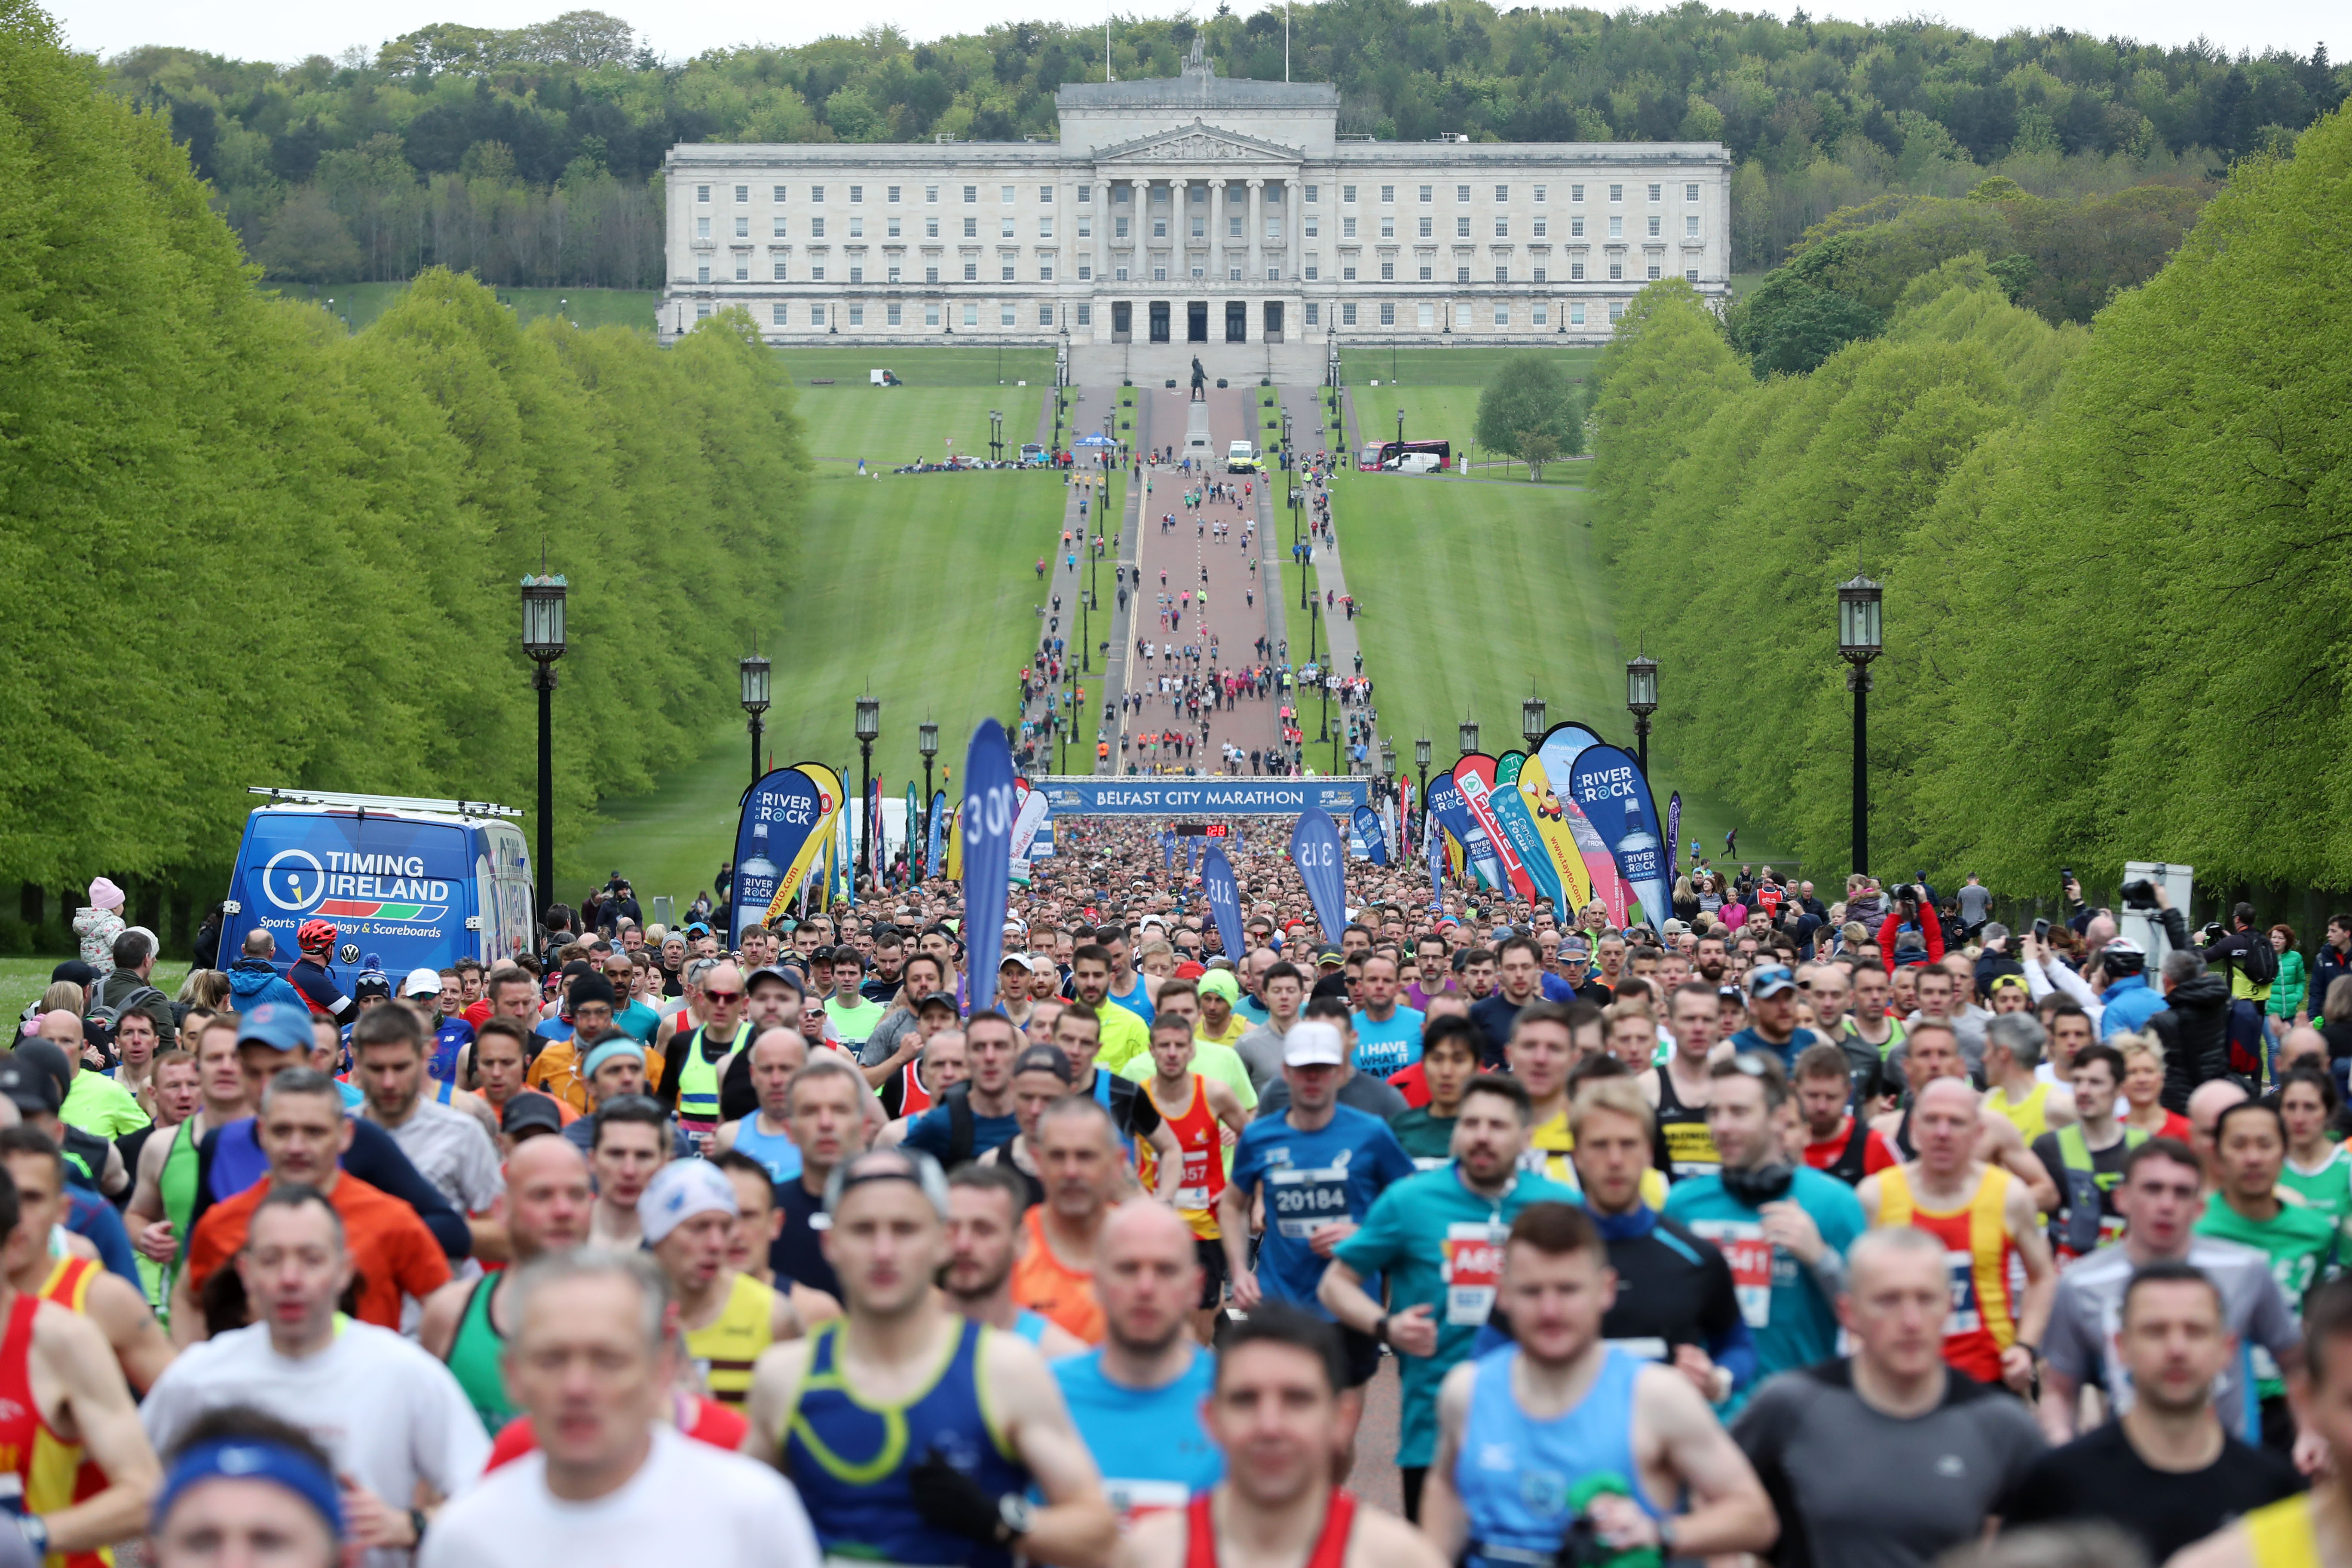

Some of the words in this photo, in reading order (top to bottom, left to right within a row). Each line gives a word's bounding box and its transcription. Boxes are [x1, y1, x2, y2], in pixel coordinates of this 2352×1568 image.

[1582, 766, 1632, 787] RIVER
[1435, 787, 1461, 802] RIVE
[1576, 775, 1586, 803] DEEP
[1584, 780, 1635, 802] ROCK
[762, 792, 812, 810] RIVER
[1097, 791, 1161, 806] BELFAST
[1165, 791, 1201, 805] CITY
[1206, 791, 1304, 805] MARATHON
[1437, 796, 1467, 812] ROC
[760, 807, 809, 825] ROCK
[1509, 820, 1529, 852] Focus
[1518, 818, 1537, 848] Cancer
[1470, 839, 1490, 849] RIVER
[1472, 845, 1491, 855] ROCK
[326, 851, 423, 877] TIMING
[1627, 851, 1655, 863] RIVER
[1550, 836, 1583, 904] www.tayto.com
[1629, 860, 1656, 873] ROCK
[329, 875, 449, 901] IRELAND
[745, 878, 773, 888] RIVER
[744, 887, 772, 898] ROCK
[259, 916, 295, 929] Sports
[298, 919, 360, 934] Tology
[361, 923, 371, 933] &
[373, 925, 441, 938] Scoreboards
[1360, 1044, 1365, 1057] I
[1368, 1040, 1408, 1055] HAVE
[1360, 1054, 1396, 1066] WHAT
[1397, 1053, 1409, 1063] IT
[1361, 1065, 1408, 1078] AKE
[1276, 1188, 1345, 1211] 20184
